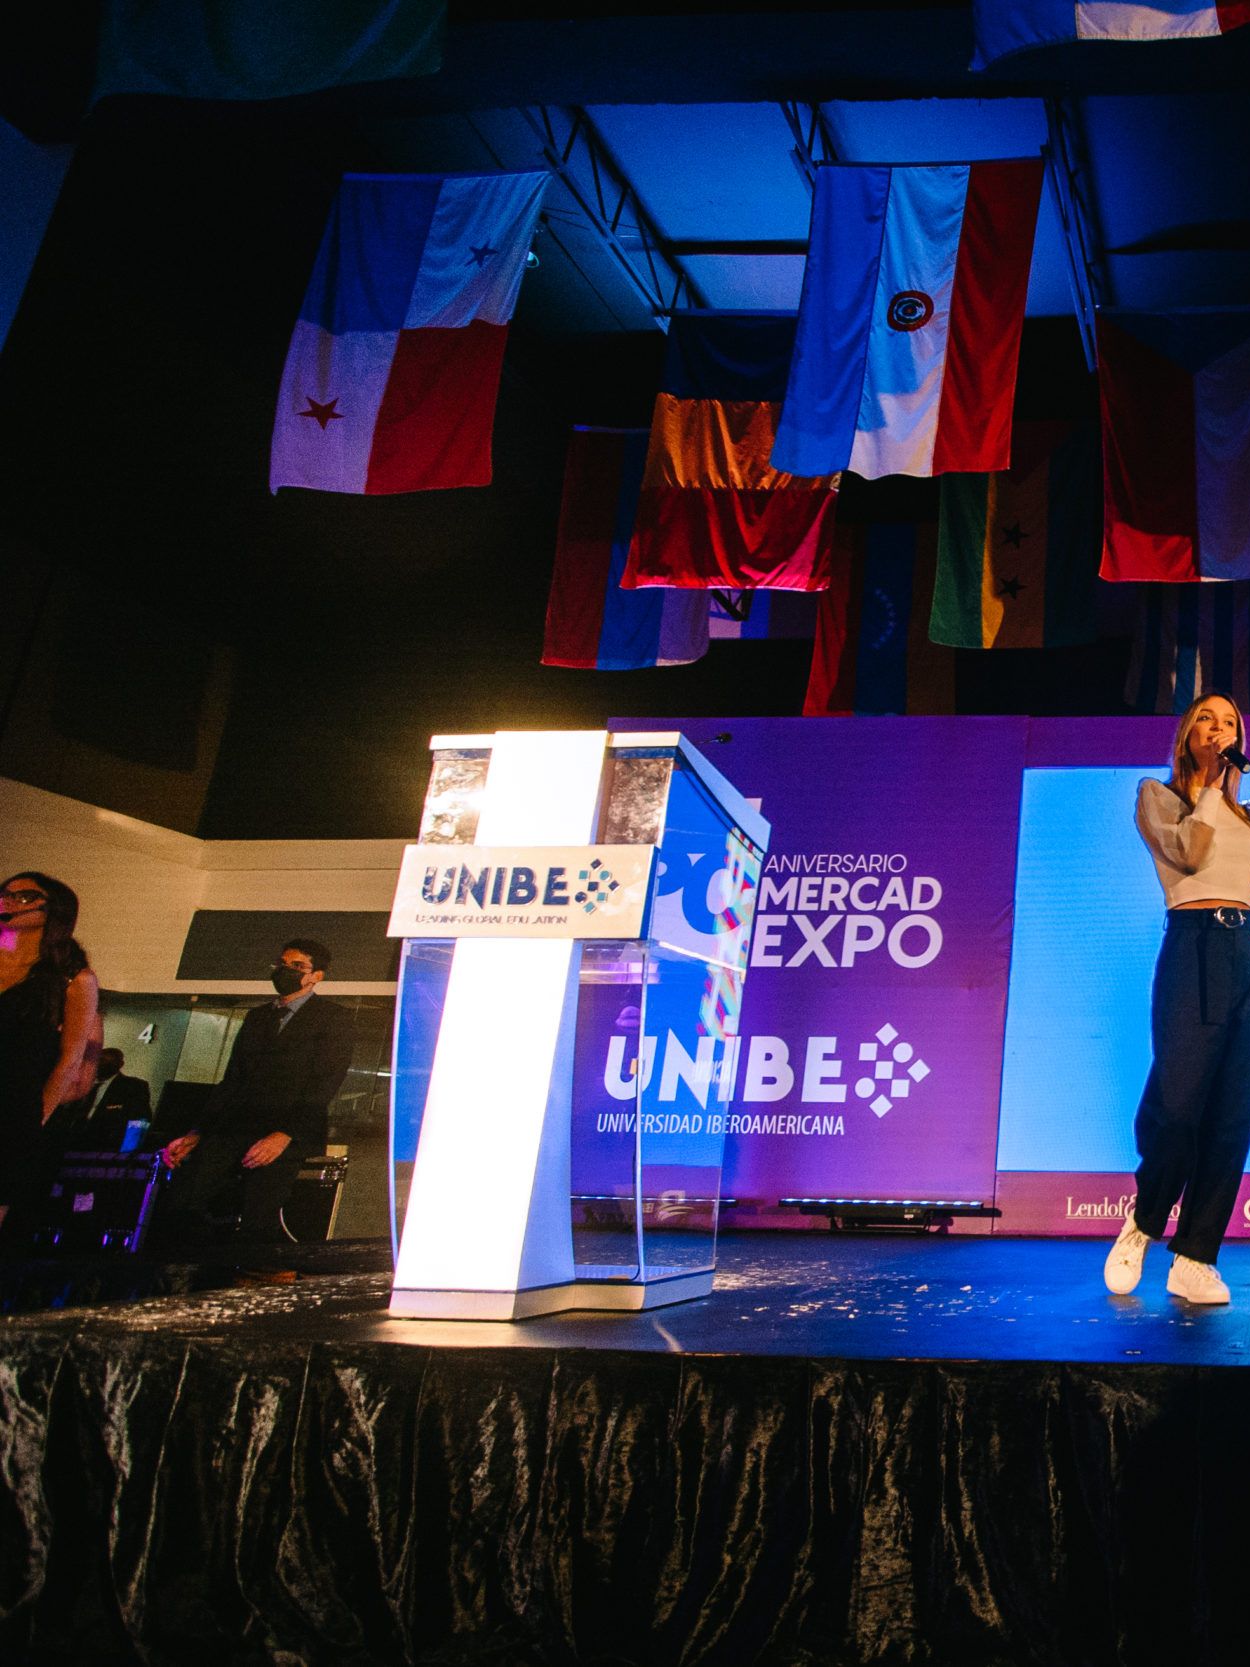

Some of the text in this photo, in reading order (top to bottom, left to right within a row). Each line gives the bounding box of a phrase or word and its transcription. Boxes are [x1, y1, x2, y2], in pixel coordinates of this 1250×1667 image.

[764, 853, 908, 873] ANIVERSARIO
[421, 862, 570, 910] UNIBE
[757, 876, 943, 912] MERCAD
[750, 913, 944, 969] EXPO
[137, 1023, 155, 1044] 4
[603, 1027, 847, 1111] UNIBE
[596, 1114, 845, 1136] UNIVERSIDAD IBEROAMERICANA
